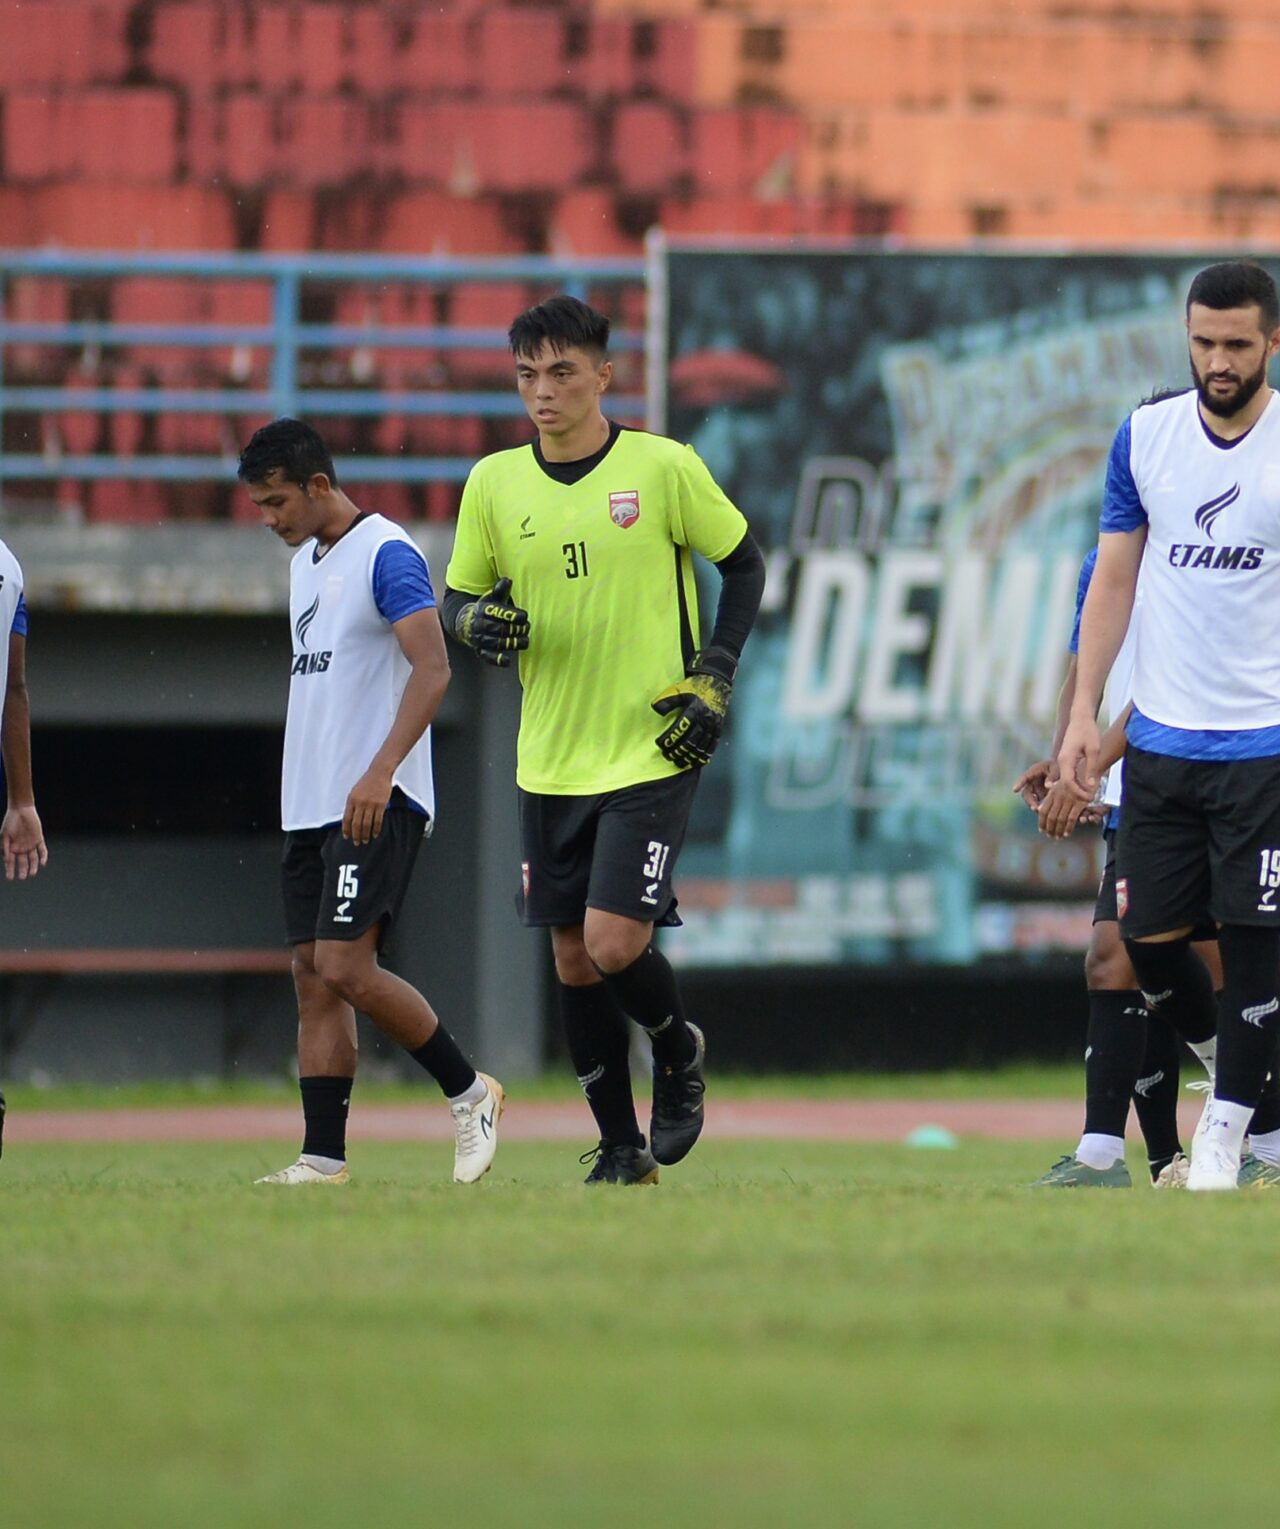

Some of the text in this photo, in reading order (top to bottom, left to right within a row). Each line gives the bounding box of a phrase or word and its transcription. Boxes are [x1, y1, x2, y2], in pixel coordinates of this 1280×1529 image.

[562, 541, 589, 579] 31
[1168, 543, 1264, 571] ETAMS
[484, 604, 517, 622] CALCI
[664, 716, 691, 748] CALCI
[643, 840, 670, 881] 31
[337, 864, 359, 899] 15
